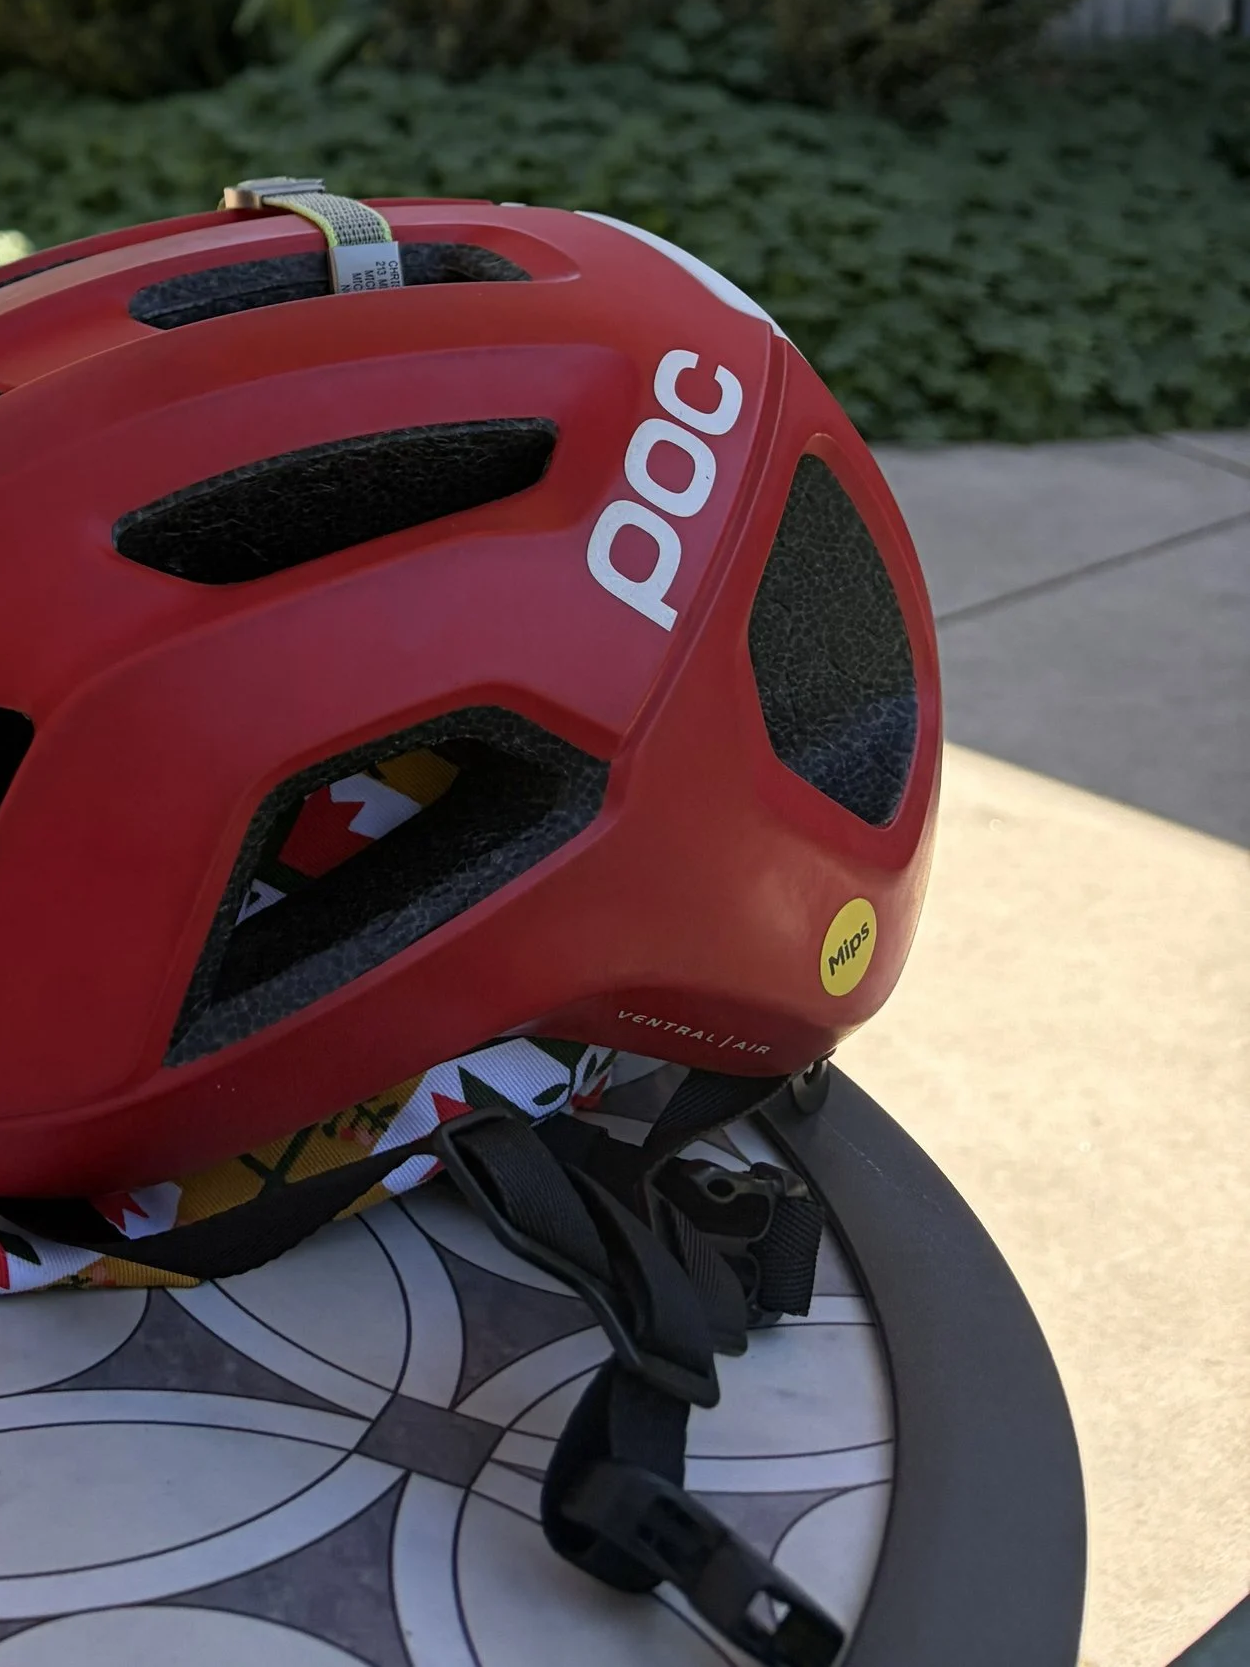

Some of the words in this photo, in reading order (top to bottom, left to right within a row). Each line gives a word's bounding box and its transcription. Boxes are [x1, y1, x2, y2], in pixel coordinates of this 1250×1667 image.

[827, 921, 870, 976] Mips
[617, 1010, 715, 1043] VENTRAL
[732, 1041, 771, 1055] AIR
